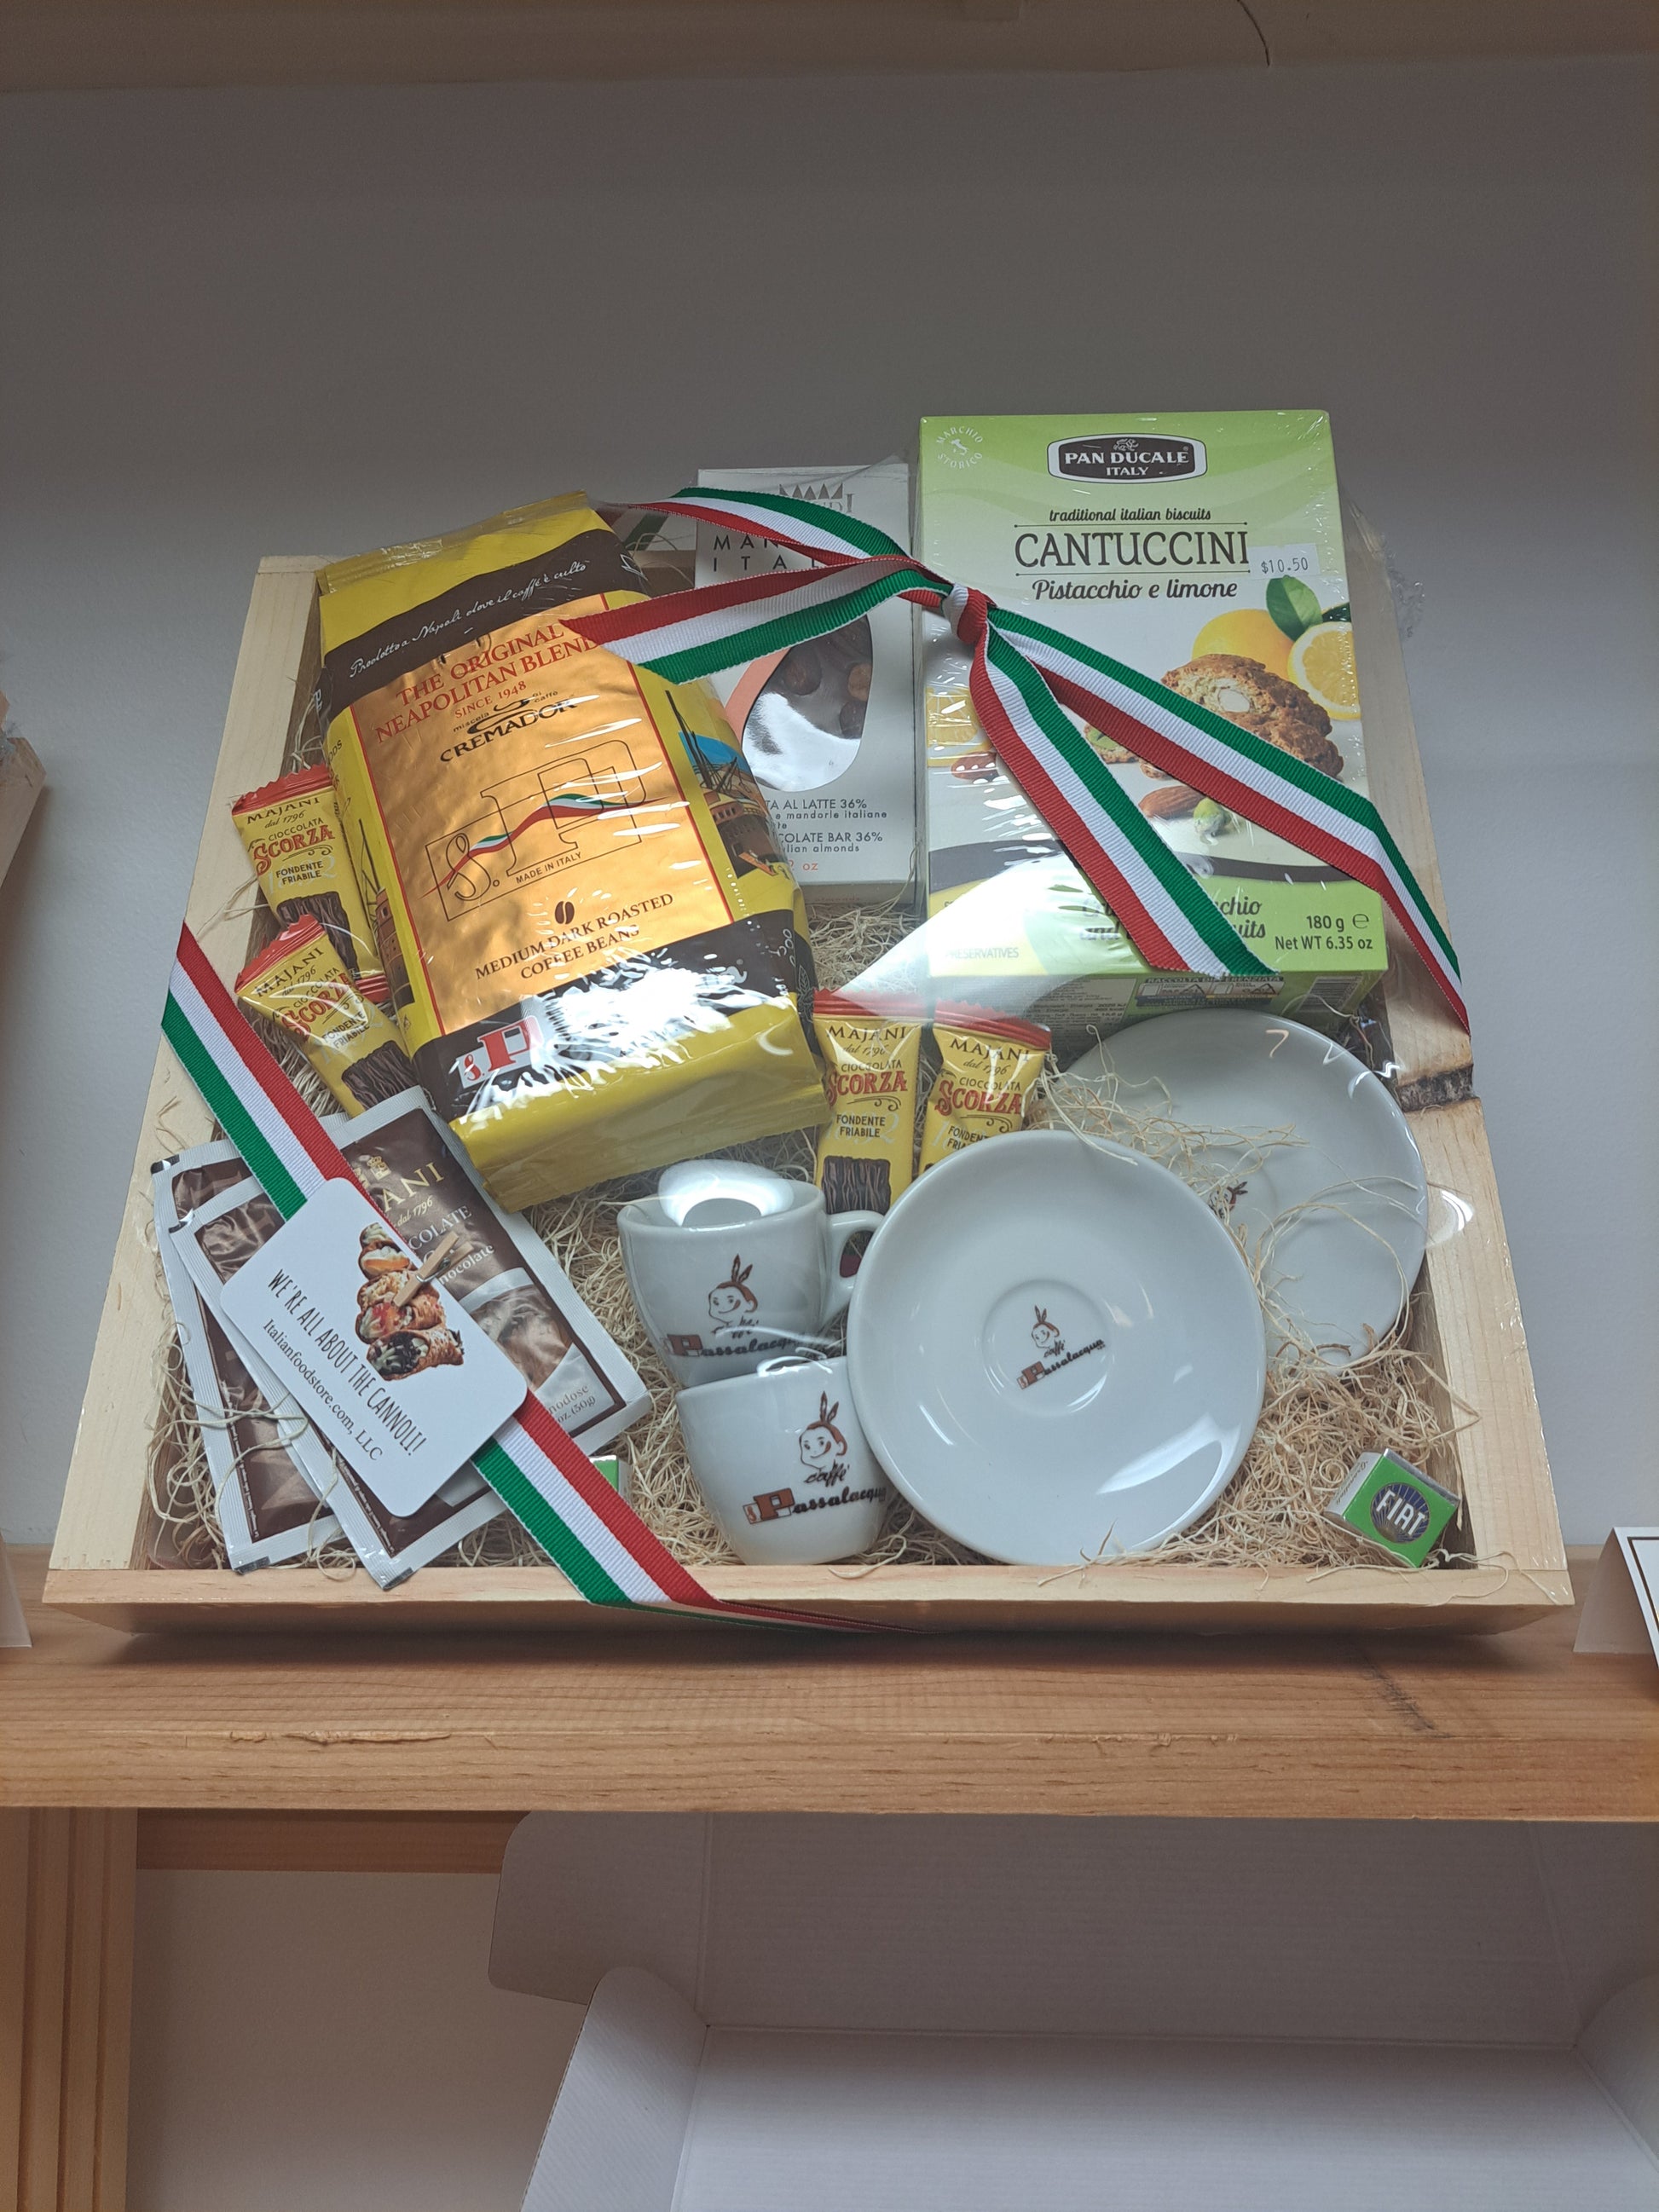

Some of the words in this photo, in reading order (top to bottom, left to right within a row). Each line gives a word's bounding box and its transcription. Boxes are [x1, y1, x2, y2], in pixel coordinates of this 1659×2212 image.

[936, 426, 983, 443] MARCHIO
[938, 453, 982, 470] STORICO
[1065, 452, 1104, 465] PAN
[1110, 451, 1189, 465] DUCALE
[1107, 467, 1148, 476] ITALY
[1049, 508, 1117, 522] traditional
[1120, 508, 1161, 521] italian
[1165, 507, 1211, 520] biscuits
[1014, 531, 1249, 568] CANTUCCINI
[1262, 557, 1309, 575] $10.50
[1032, 579, 1143, 600] Pistacchio
[1148, 584, 1160, 598] e
[1166, 578, 1238, 598] limone
[350, 643, 400, 678] Prodotto
[412, 609, 462, 641] Napoli
[465, 599, 495, 617] dove
[497, 589, 513, 604] il
[396, 673, 444, 706] THE
[450, 624, 564, 680] ORIGINAL
[374, 661, 517, 743] NEAPOLITAN
[520, 637, 599, 674] BLEND
[454, 696, 493, 719] SINCE
[498, 680, 527, 699] 1948
[440, 698, 577, 762] CREMADOR
[247, 798, 320, 824] MAJANI
[783, 800, 798, 810] AL
[802, 799, 836, 809] LATTE
[840, 799, 867, 809] 36%
[786, 810, 839, 819] mandorle
[844, 810, 887, 818] italiane
[265, 817, 280, 829] dal
[283, 809, 307, 823] 1796
[269, 817, 324, 840] CIOCCOLATA
[813, 843, 860, 852] almonds
[828, 832, 852, 843] BAR
[855, 832, 883, 842] 36%
[253, 824, 335, 876] SCORZA
[276, 861, 323, 879] FONDENTE
[282, 870, 321, 885] FRIABILE
[516, 868, 543, 884] MADE
[545, 863, 554, 872] IN
[555, 852, 582, 868] ITALY
[802, 863, 818, 871] oz
[1306, 915, 1332, 929] 180
[1335, 918, 1344, 933] g
[475, 942, 546, 980] MEDIUM
[549, 921, 595, 950] DARK
[596, 893, 673, 929] ROASTED
[1275, 937, 1298, 950] Net
[1300, 936, 1321, 950] WT
[1326, 936, 1354, 950] 6.35
[1357, 938, 1373, 950] oz
[520, 947, 584, 979] COFFEE
[586, 924, 639, 954] BEANS
[944, 947, 1019, 960] PRESERVATIVES
[256, 948, 324, 997] MAJANI
[322, 1011, 366, 1042] FONDENTE
[333, 1024, 370, 1048] FRIABILE
[827, 1025, 907, 1043] MAJANI
[843, 1044, 860, 1054] dal
[863, 1044, 889, 1056] 1796
[950, 1038, 1030, 1061] MAJANI
[841, 1060, 902, 1072] CIOCCOLATA
[963, 1059, 983, 1069] dal
[827, 1070, 908, 1107] SCORZA
[934, 1080, 1022, 1116] SCORZA
[836, 1114, 886, 1126] FONDENTE
[840, 1126, 880, 1137] FRIABILE
[397, 1210, 412, 1227] dal
[413, 1195, 433, 1216] 1796
[408, 1205, 471, 1250] COLATE
[268, 1268, 307, 1315] WE'RE
[297, 1308, 325, 1337] ALL
[315, 1328, 358, 1374] ABOUT
[348, 1364, 376, 1396] THE
[367, 1388, 427, 1456] CANNOLI!
[263, 1319, 355, 1435] Italianfoodstore.com,
[355, 1429, 383, 1461] LLC
[571, 1395, 596, 1415] (50g)
[1376, 1489, 1426, 1535] FIAT
